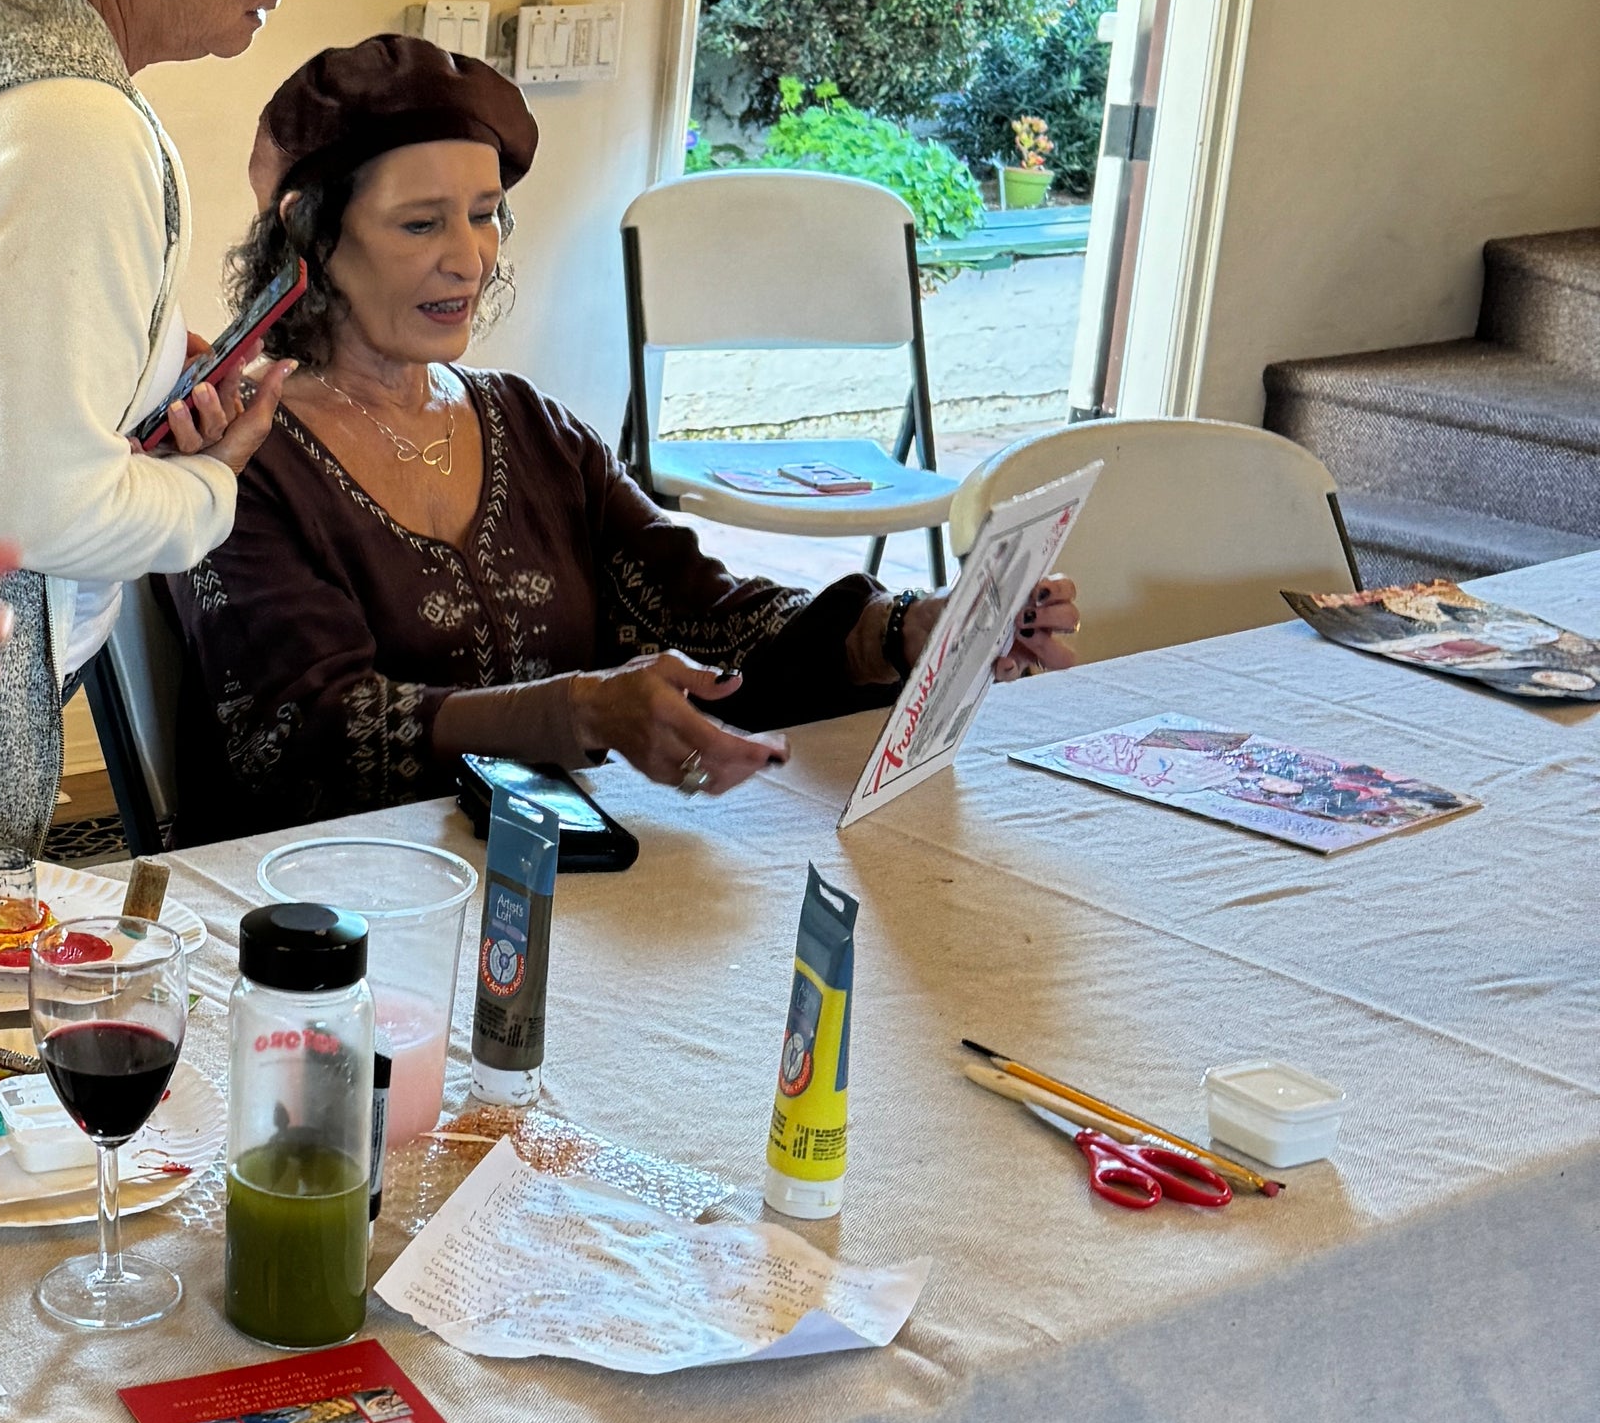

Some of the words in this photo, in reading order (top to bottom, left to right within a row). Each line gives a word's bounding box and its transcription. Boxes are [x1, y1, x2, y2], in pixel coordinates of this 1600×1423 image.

[873, 630, 951, 794] Fredrix
[496, 903, 512, 924] Loft
[497, 893, 524, 918] Artist's
